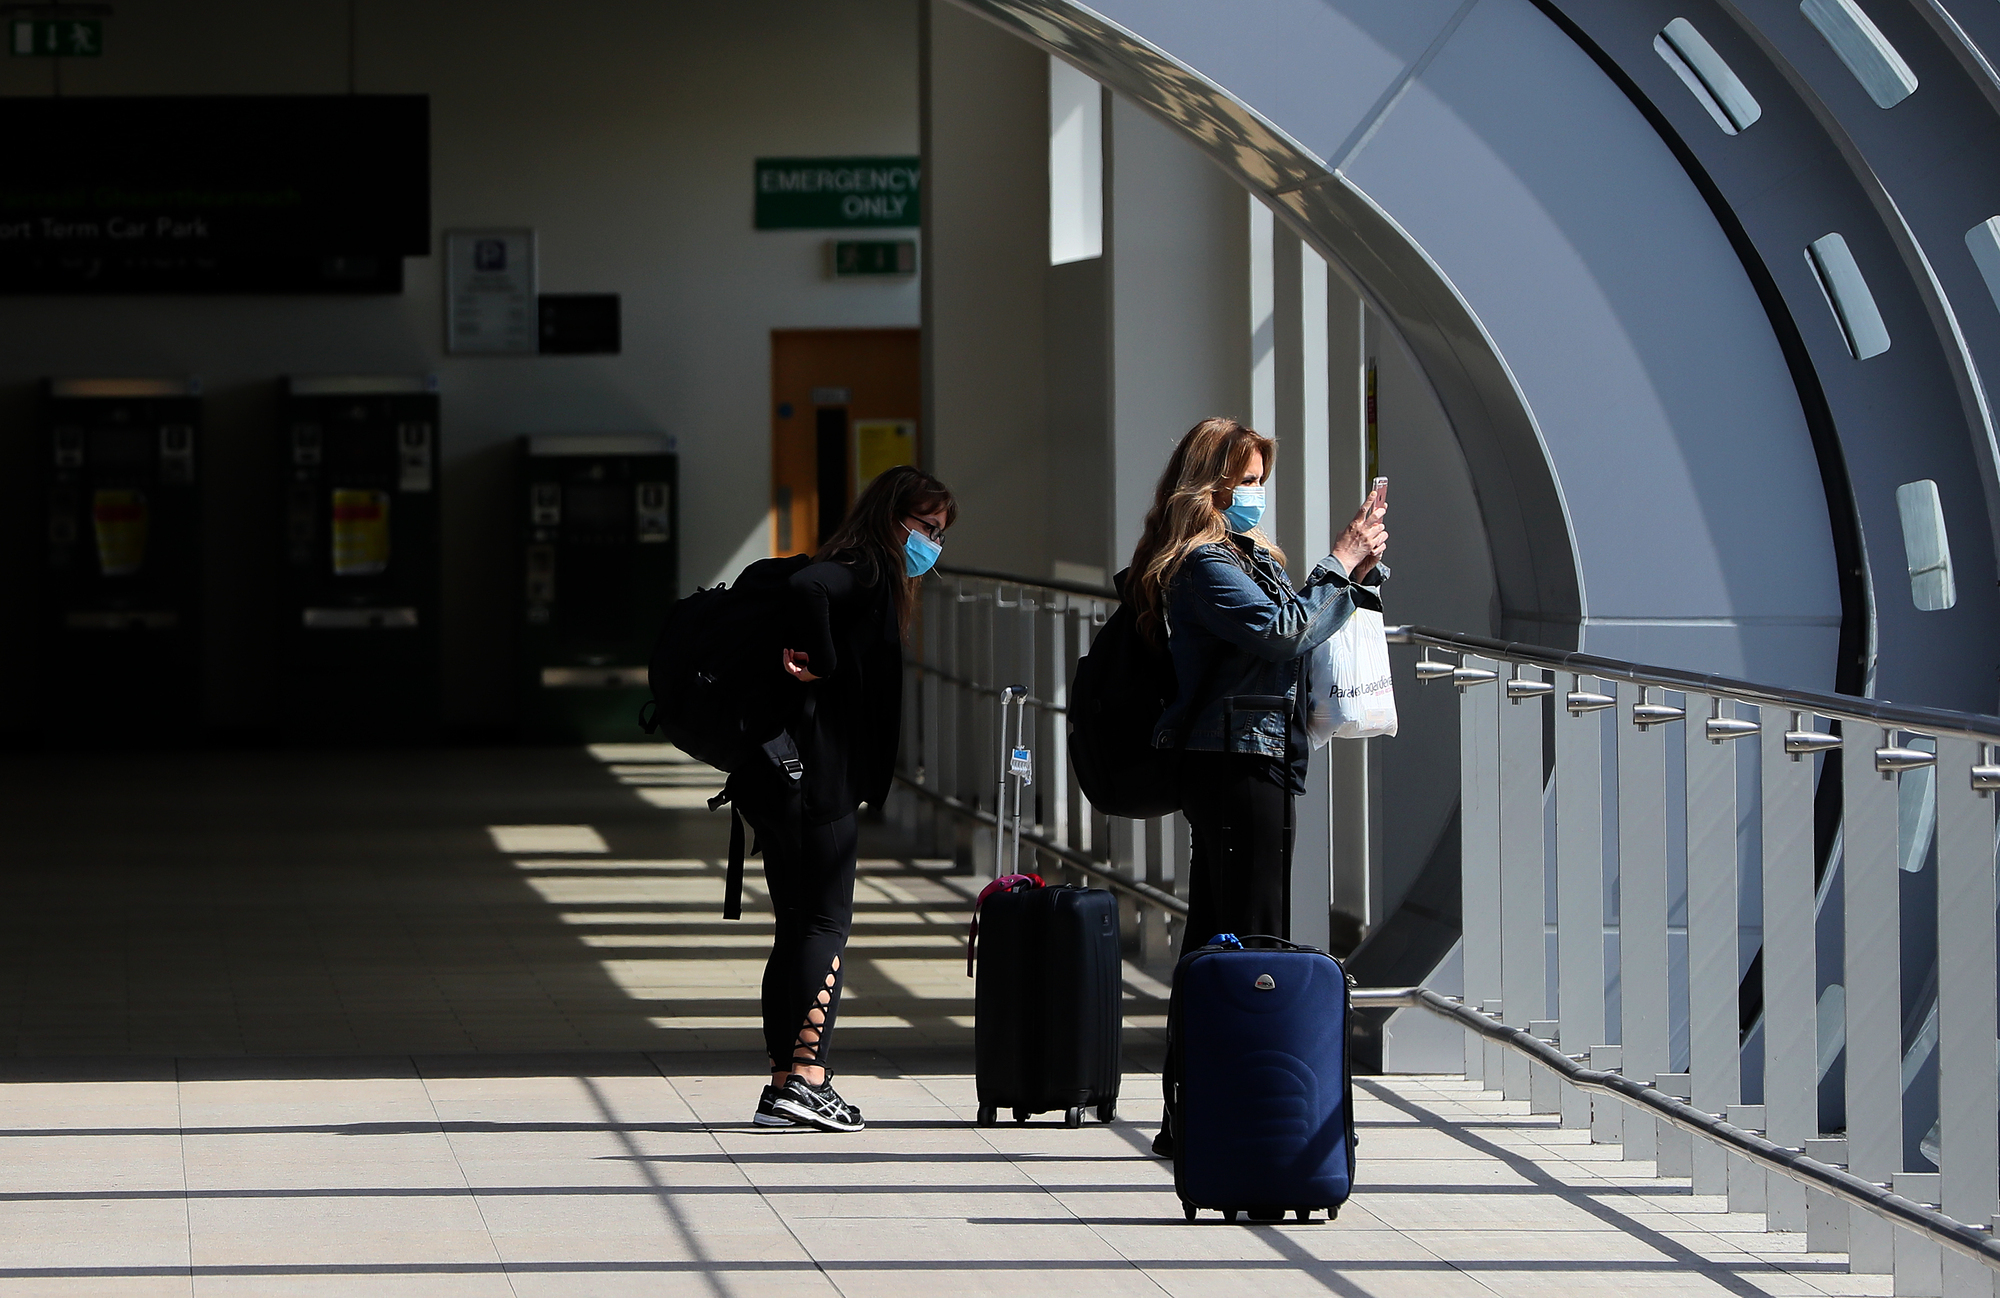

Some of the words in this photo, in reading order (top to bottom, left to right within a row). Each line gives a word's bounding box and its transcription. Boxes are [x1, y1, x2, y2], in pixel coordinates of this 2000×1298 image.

[760, 167, 921, 193] EMERGENCY
[841, 194, 908, 220] ONLY
[40, 216, 99, 240] Term
[106, 216, 147, 240] Car
[155, 215, 209, 240] Park
